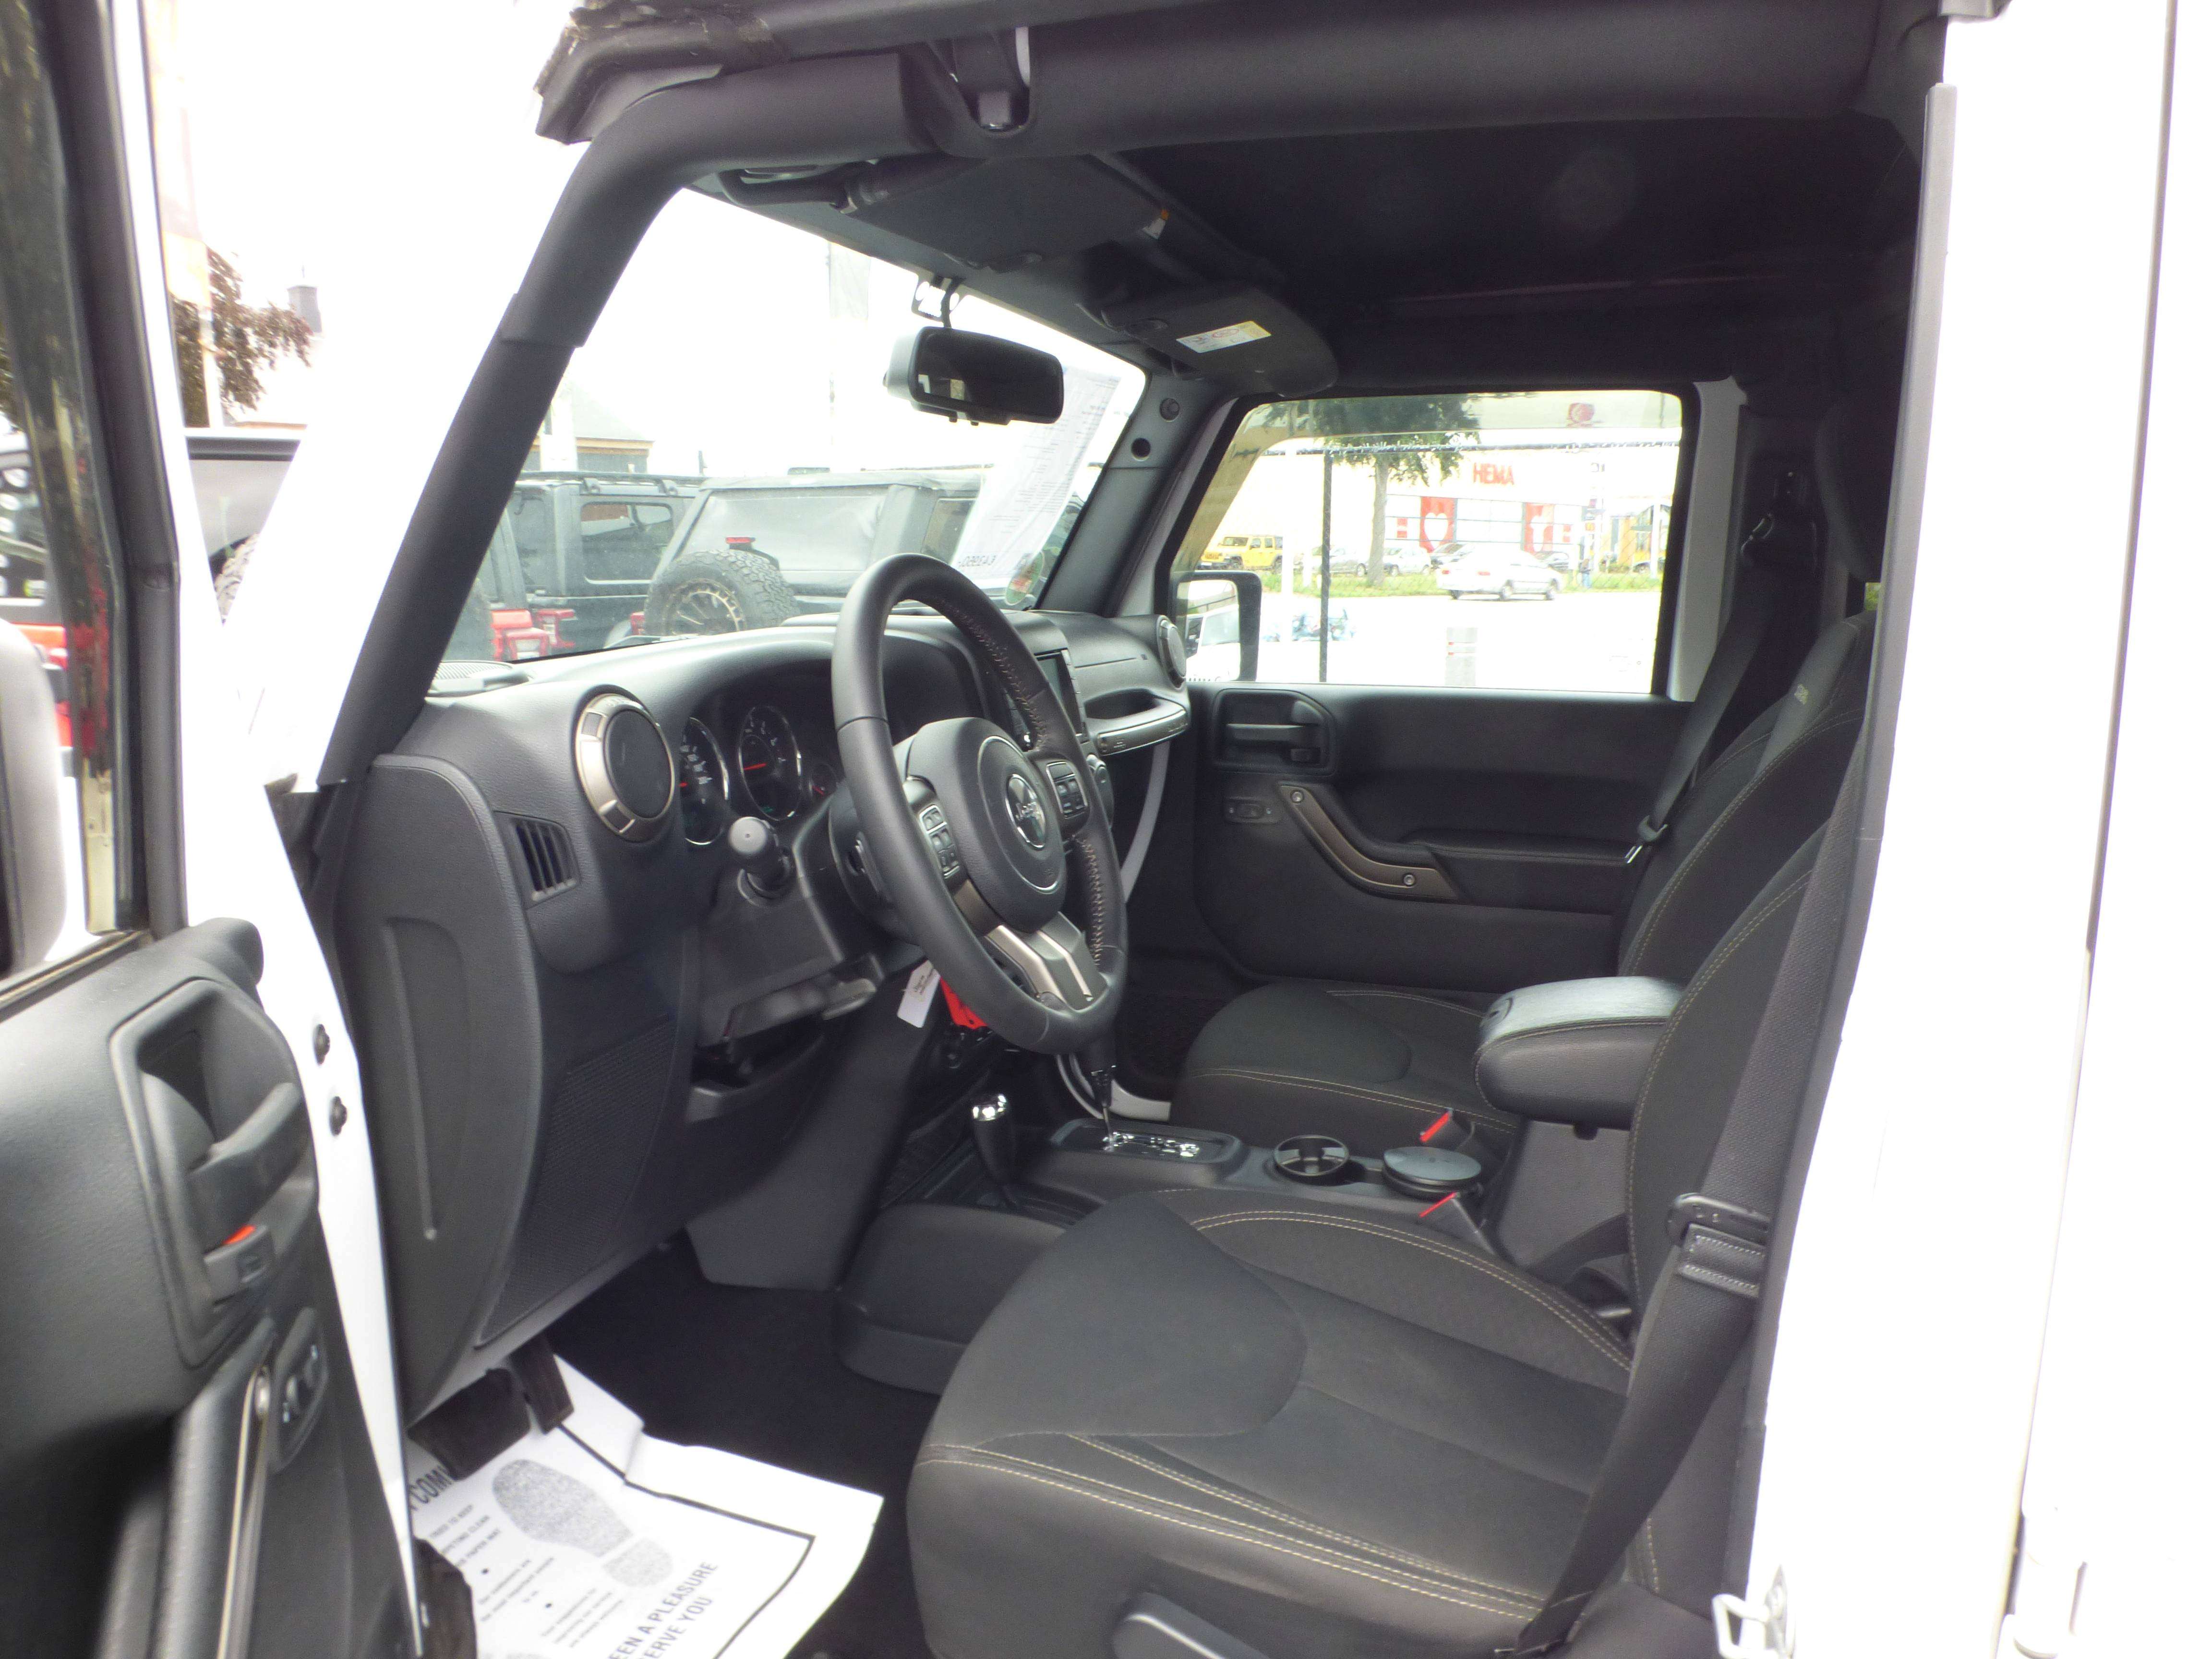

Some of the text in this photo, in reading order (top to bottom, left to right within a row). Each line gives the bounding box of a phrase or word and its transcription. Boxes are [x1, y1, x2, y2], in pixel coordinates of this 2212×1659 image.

[1473, 462, 1514, 485] HEMA
[637, 1626, 656, 1634] A
[648, 1562, 718, 1622] PLEASURE
[639, 1597, 713, 1659] ERVE YOU
